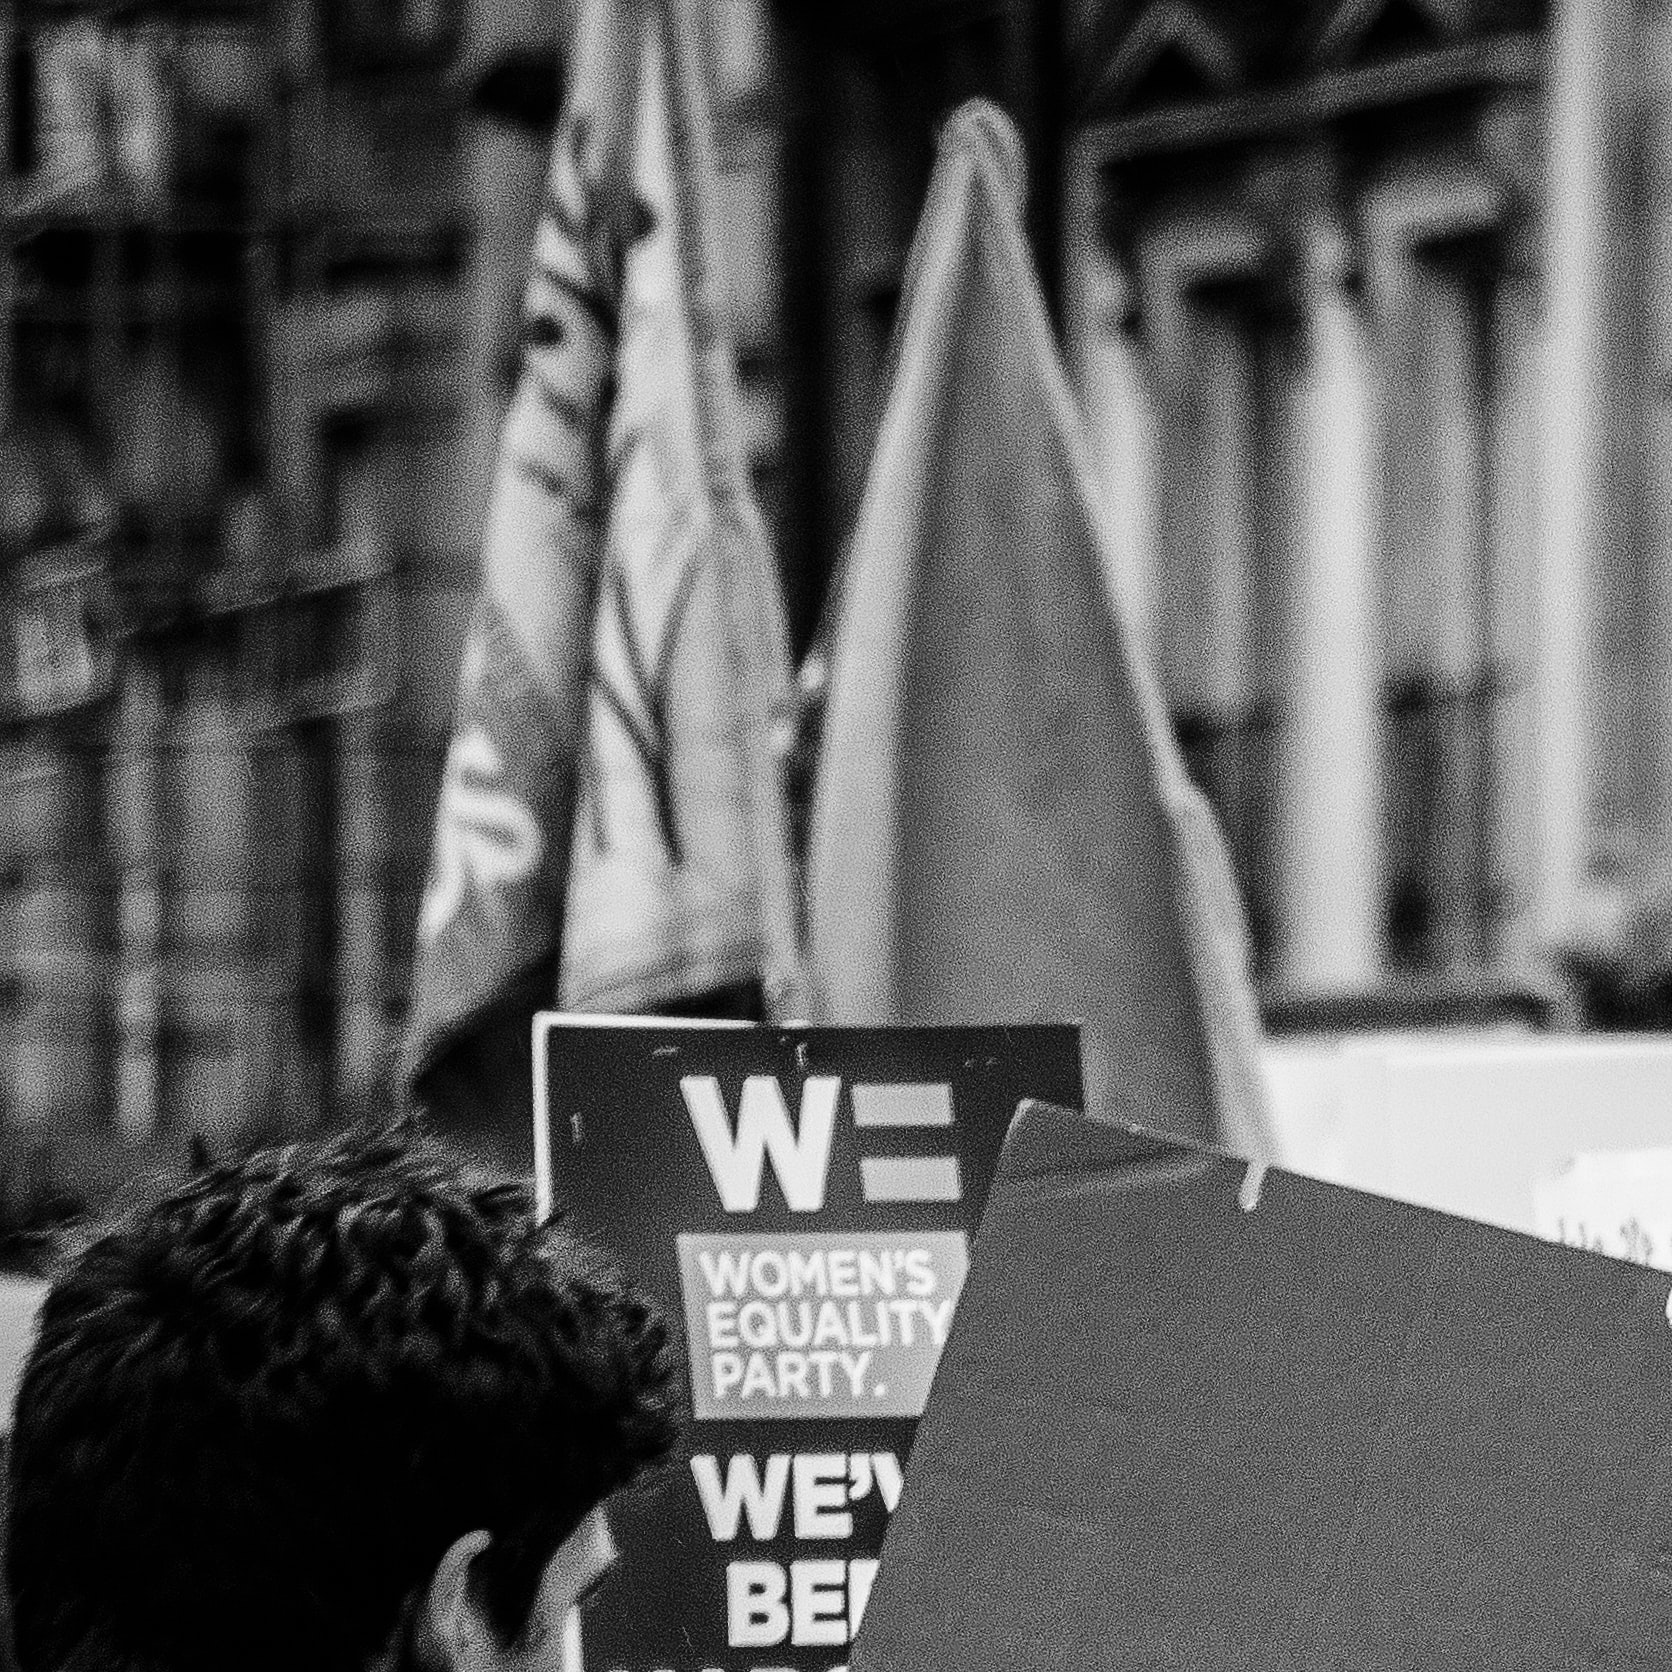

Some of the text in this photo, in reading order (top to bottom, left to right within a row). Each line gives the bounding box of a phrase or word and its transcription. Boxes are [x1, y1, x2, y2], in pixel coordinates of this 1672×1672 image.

[700, 1250, 937, 1297] WOMEN'S
[706, 1300, 954, 1348] EQUALITY
[711, 1351, 885, 1398] PARTY.
